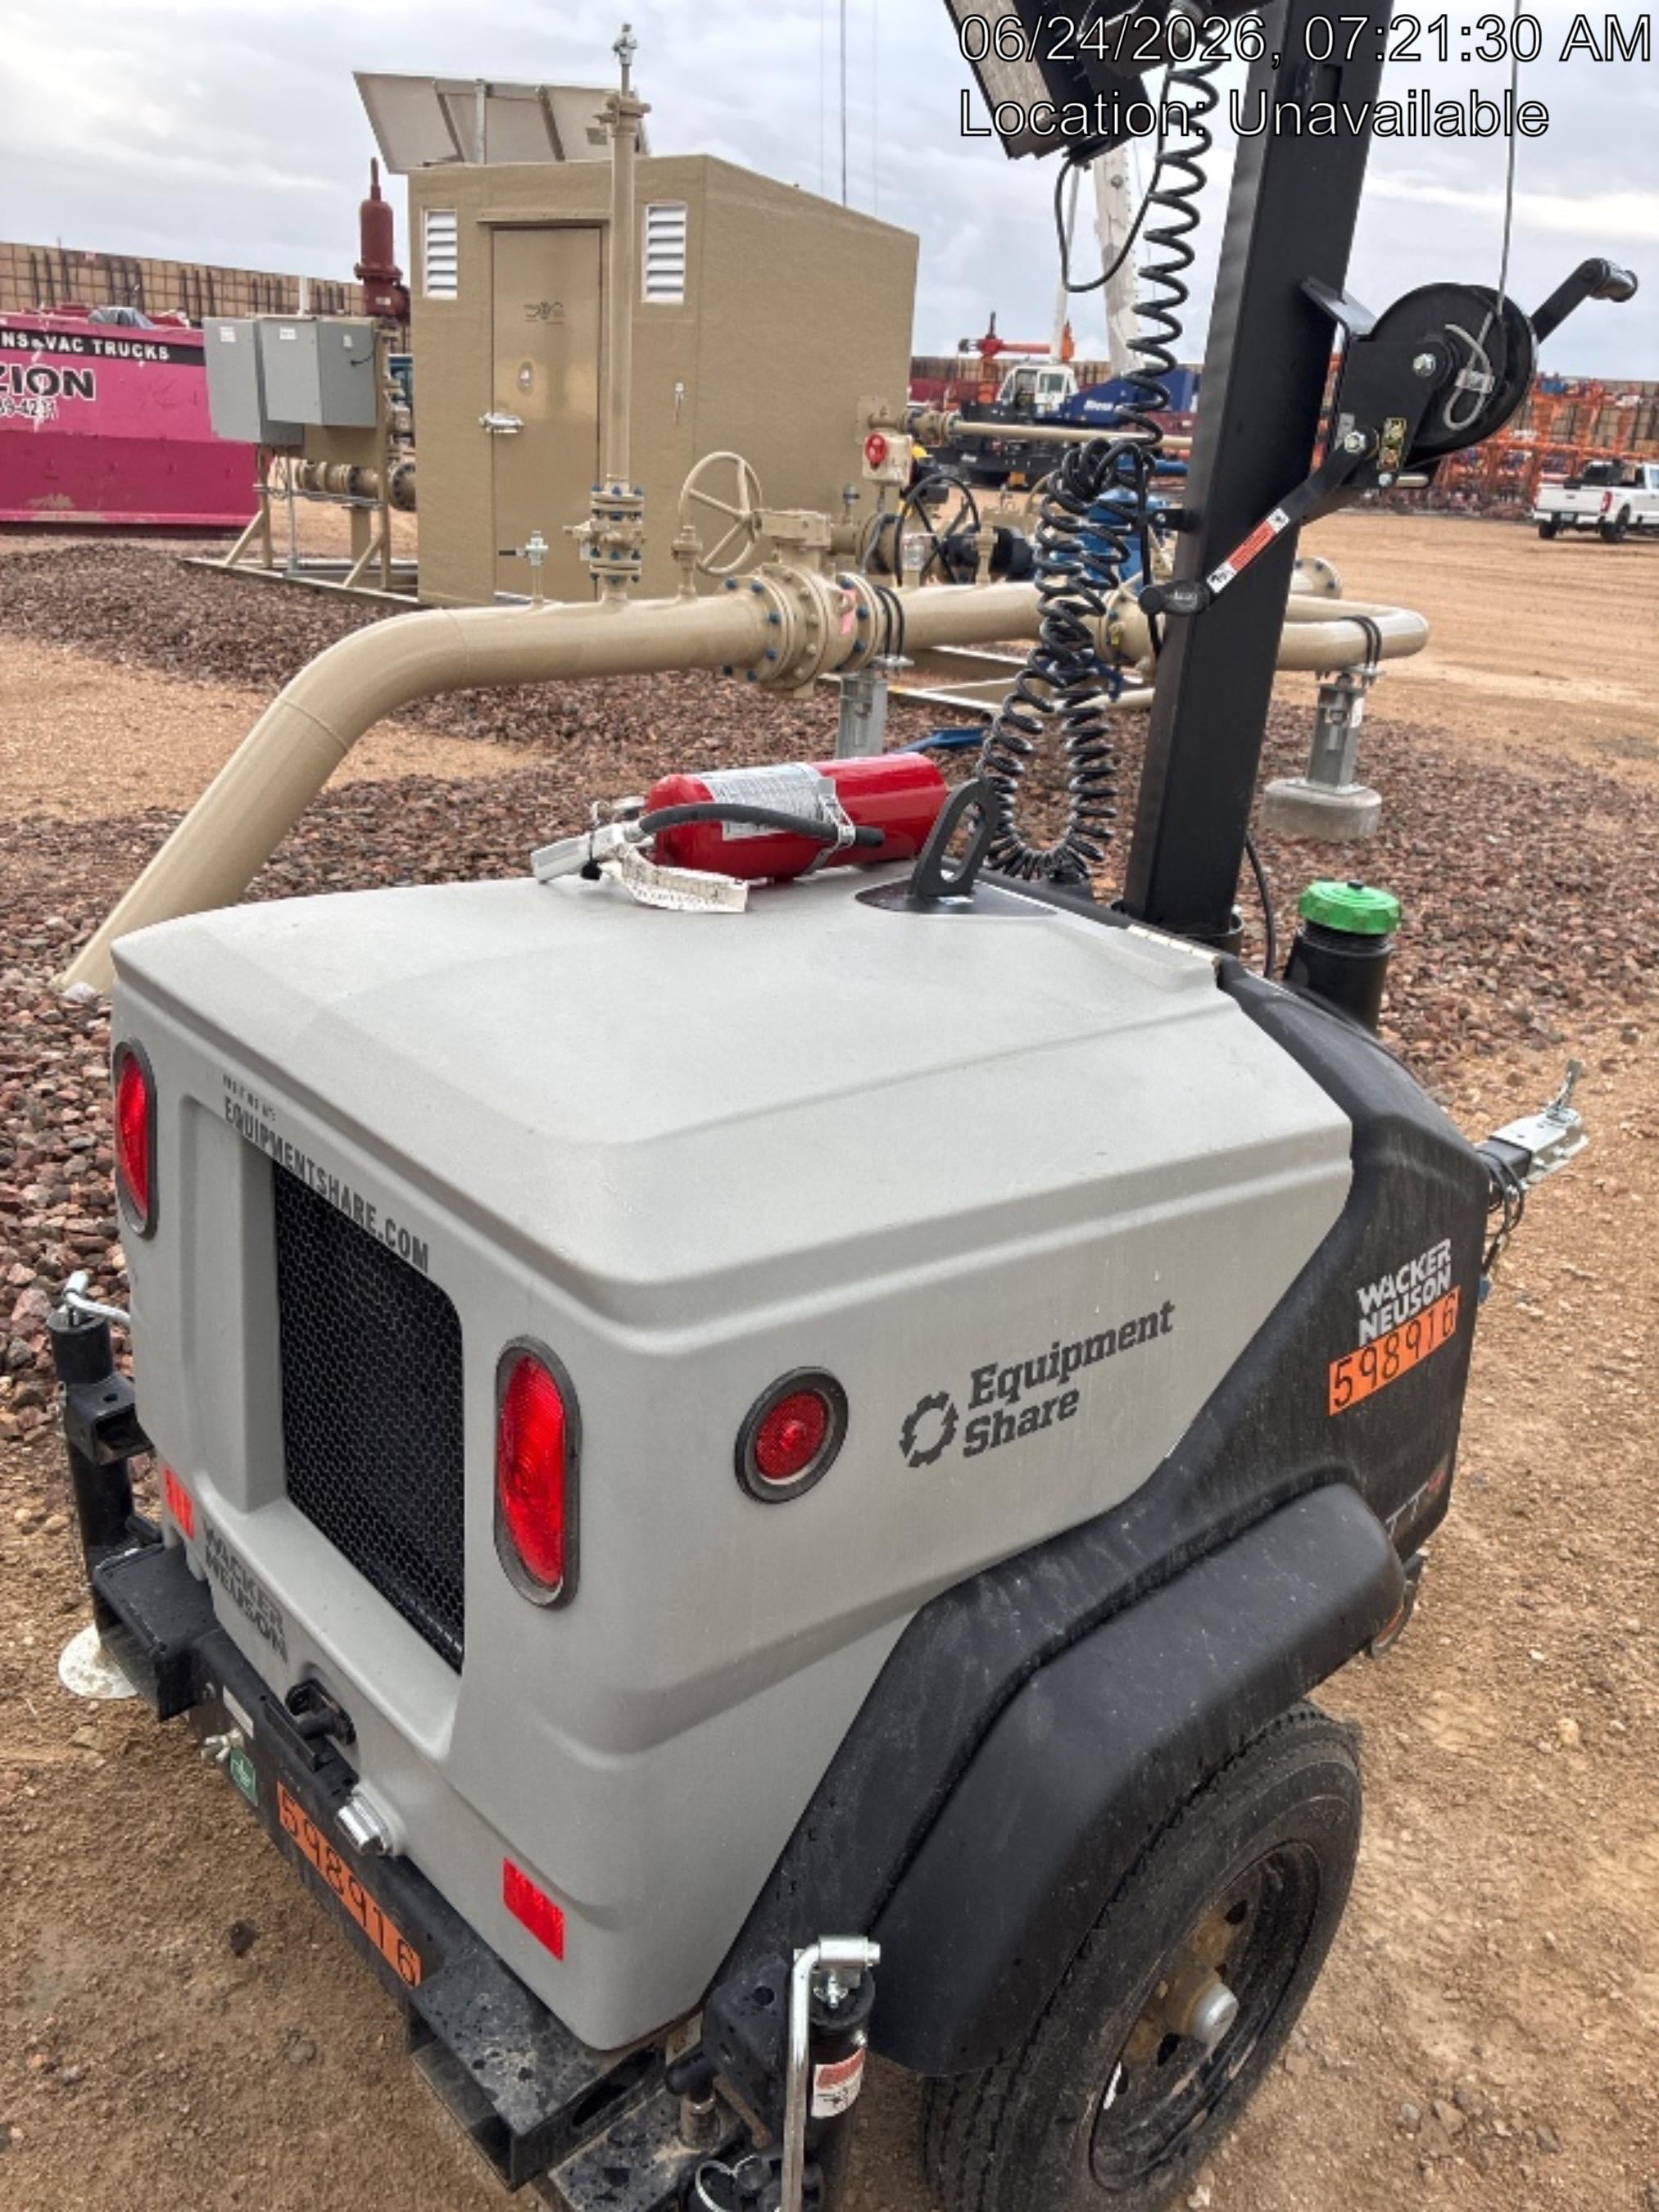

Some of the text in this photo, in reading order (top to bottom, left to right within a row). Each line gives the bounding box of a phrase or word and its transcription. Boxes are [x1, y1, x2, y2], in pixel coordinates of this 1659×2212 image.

[93, 340, 170, 360] TRUCKS
[224, 1095, 428, 1274] EQUIPMENTSHARE.COM
[1356, 1238, 1452, 1315] WACKER
[1358, 1262, 1452, 1347] NEUSON
[968, 1299, 1176, 1411] Equipment
[1334, 1292, 1457, 1407] 598916
[963, 1388, 1080, 1458] Share
[281, 1788, 417, 1987] 598916
